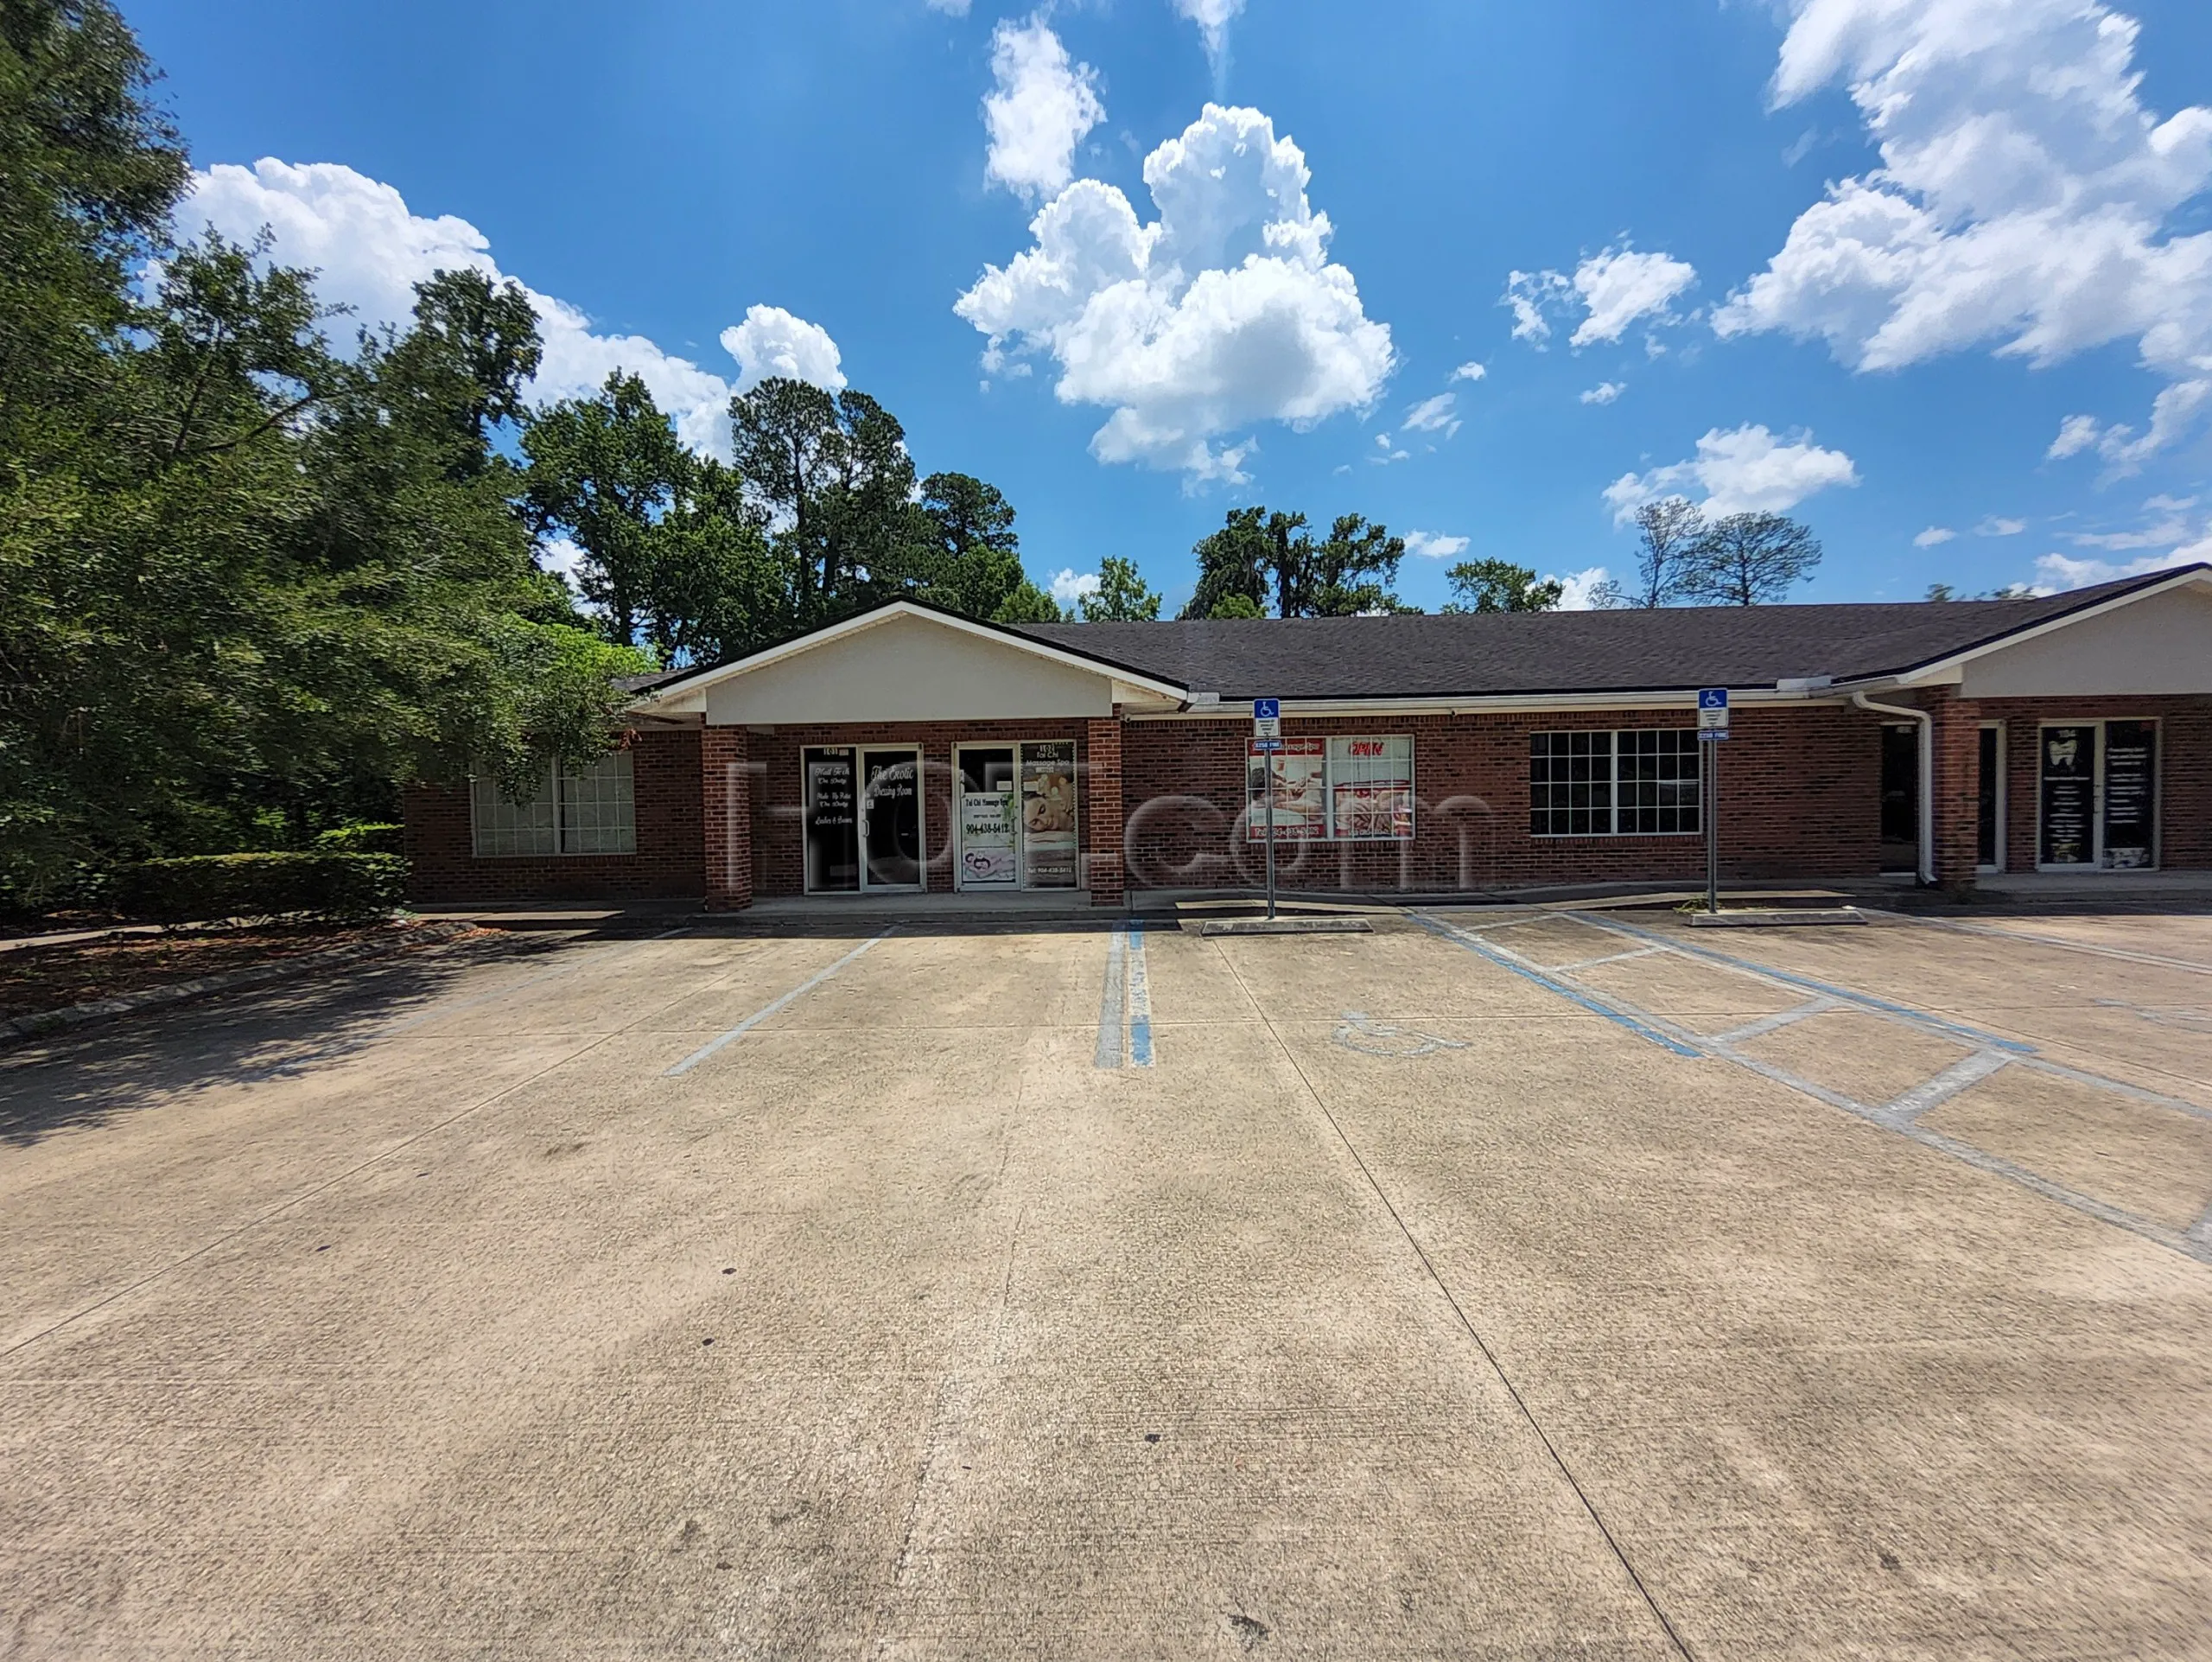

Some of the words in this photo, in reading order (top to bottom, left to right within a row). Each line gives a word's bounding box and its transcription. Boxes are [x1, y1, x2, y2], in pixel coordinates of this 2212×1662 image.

[1348, 741, 1384, 756] OPEN
[1026, 759, 1056, 767] Massage
[1057, 758, 1071, 767] Spa
[871, 765, 887, 781] The
[889, 764, 913, 780] Exotic
[896, 783, 912, 797] Room
